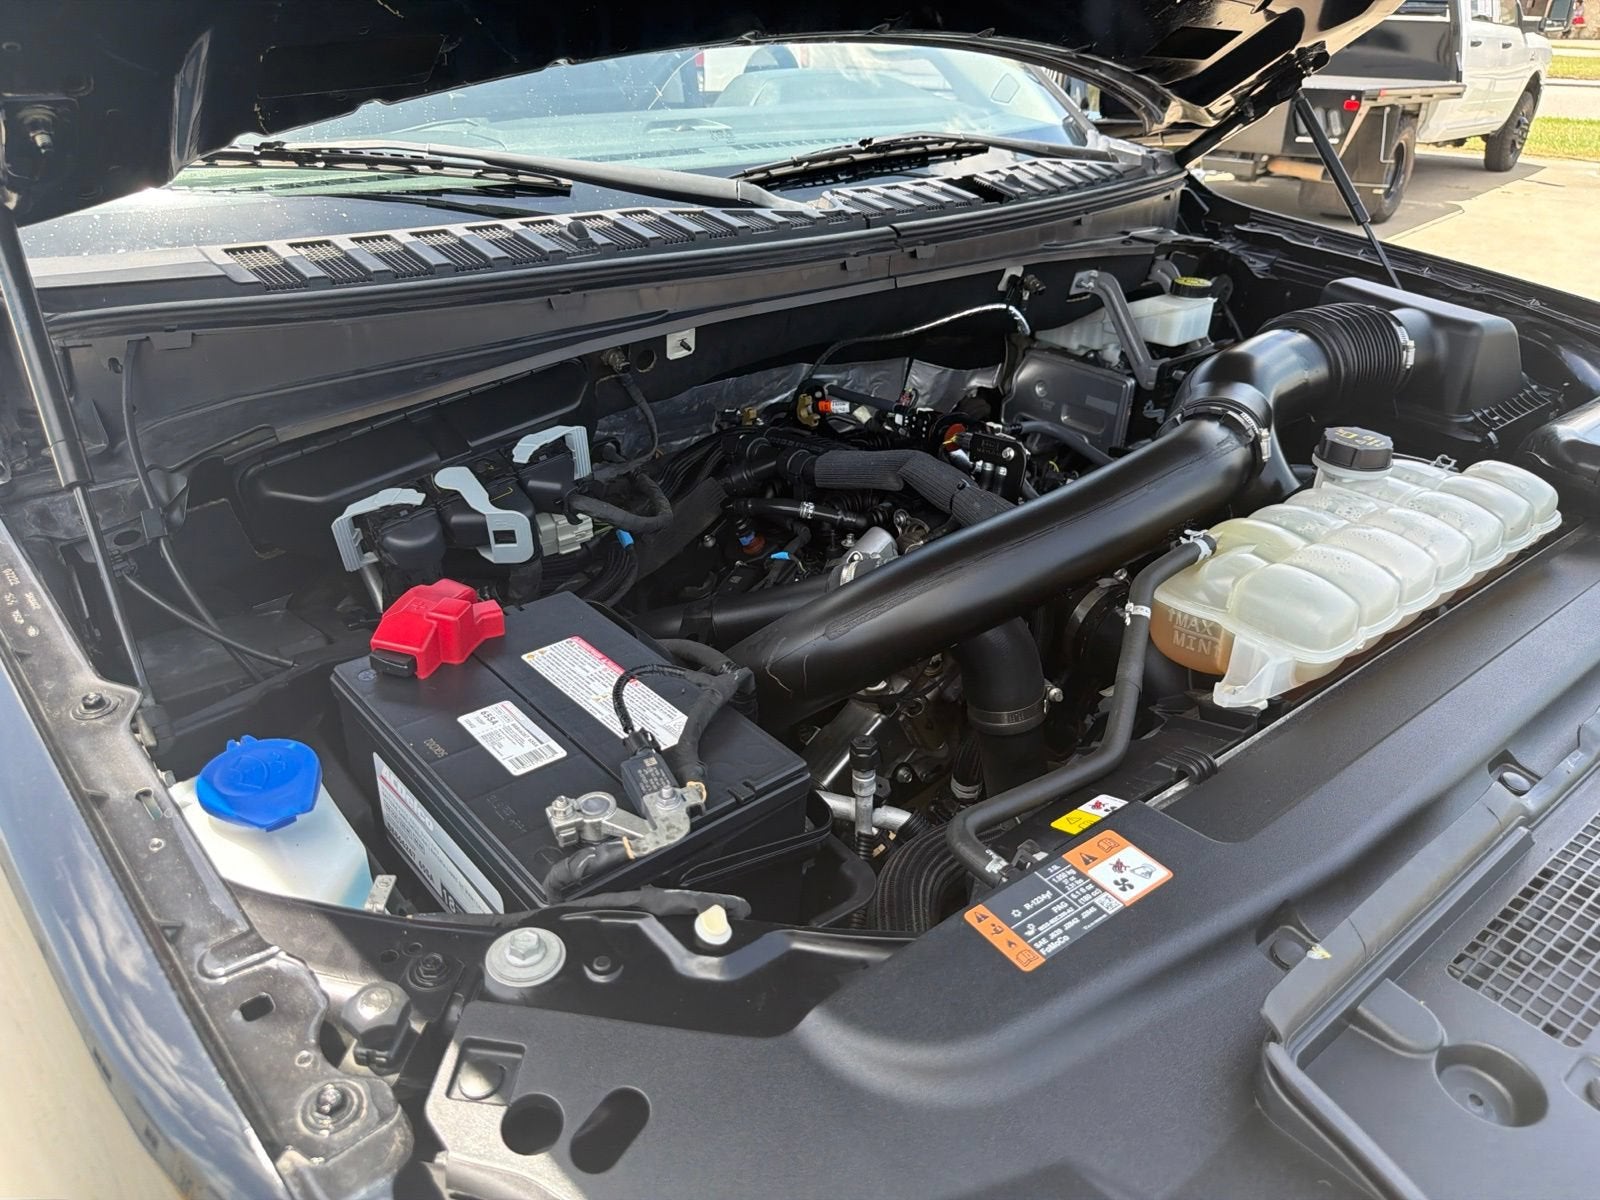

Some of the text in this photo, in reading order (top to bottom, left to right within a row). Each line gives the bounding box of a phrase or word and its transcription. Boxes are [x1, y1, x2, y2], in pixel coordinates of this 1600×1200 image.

[1175, 611, 1214, 636] MAX
[1173, 630, 1212, 655] MIN
[480, 710, 499, 726] 65SA
[1064, 868, 1077, 876] kg
[1023, 890, 1053, 910] R-1234yf
[1051, 901, 1069, 913] PAG
[1033, 937, 1049, 949] SAE
[1039, 935, 1070, 955] FoMoCo
